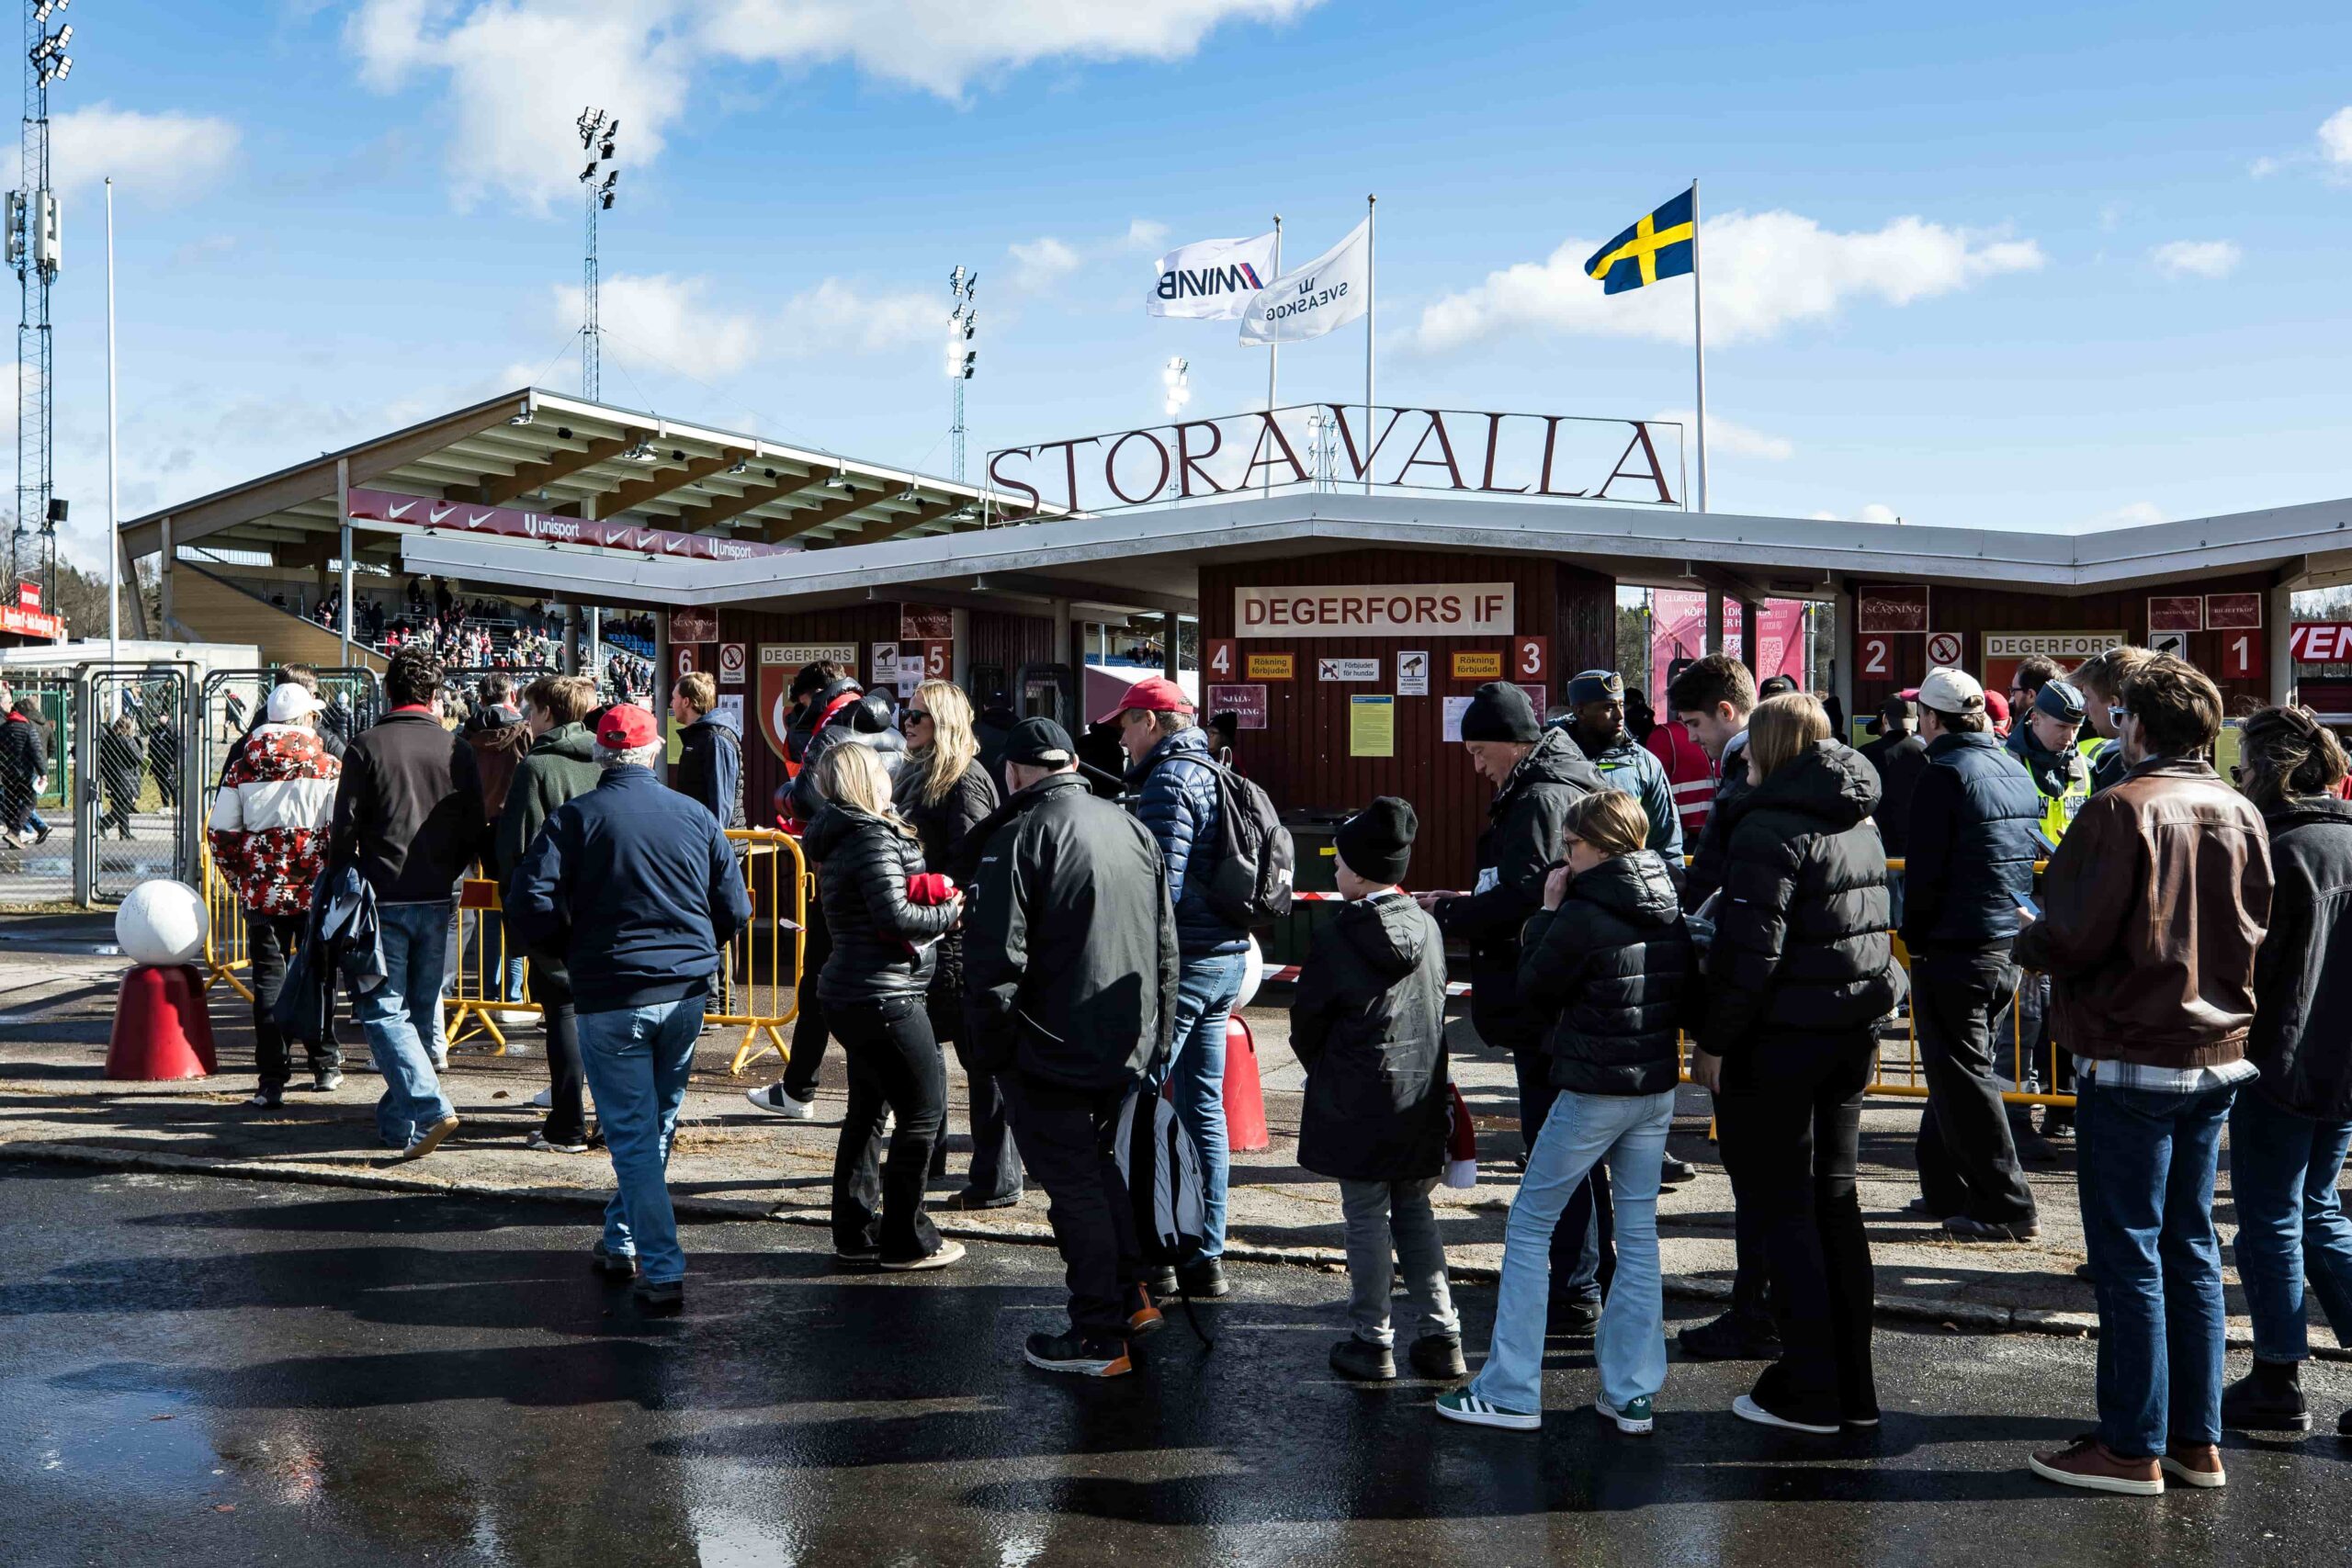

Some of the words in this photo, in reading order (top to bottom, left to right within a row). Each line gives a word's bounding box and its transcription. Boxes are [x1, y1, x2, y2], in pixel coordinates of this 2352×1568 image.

[989, 412, 1314, 521] STORA
[1326, 404, 1678, 504] VALLA
[538, 517, 580, 540] unisport
[719, 541, 752, 561] unisport
[1244, 595, 1462, 626] DEGERFORS
[1475, 595, 1504, 622] IF
[1865, 604, 1922, 614] SCANNING
[763, 649, 853, 661] DEGERFORS
[1865, 639, 1886, 672] 2
[1991, 638, 2117, 653] DEGERFORS
[2232, 636, 2248, 671] 1
[678, 649, 692, 677] 6
[930, 646, 944, 674] 5
[1211, 645, 1230, 674] 4
[1254, 658, 1287, 667] Rökning
[1344, 661, 1374, 670] Förbjudet
[1460, 656, 1495, 666] Rökning
[1521, 642, 1541, 674] 3
[1251, 667, 1290, 676] förbjuden
[1457, 665, 1498, 675] förbjuden
